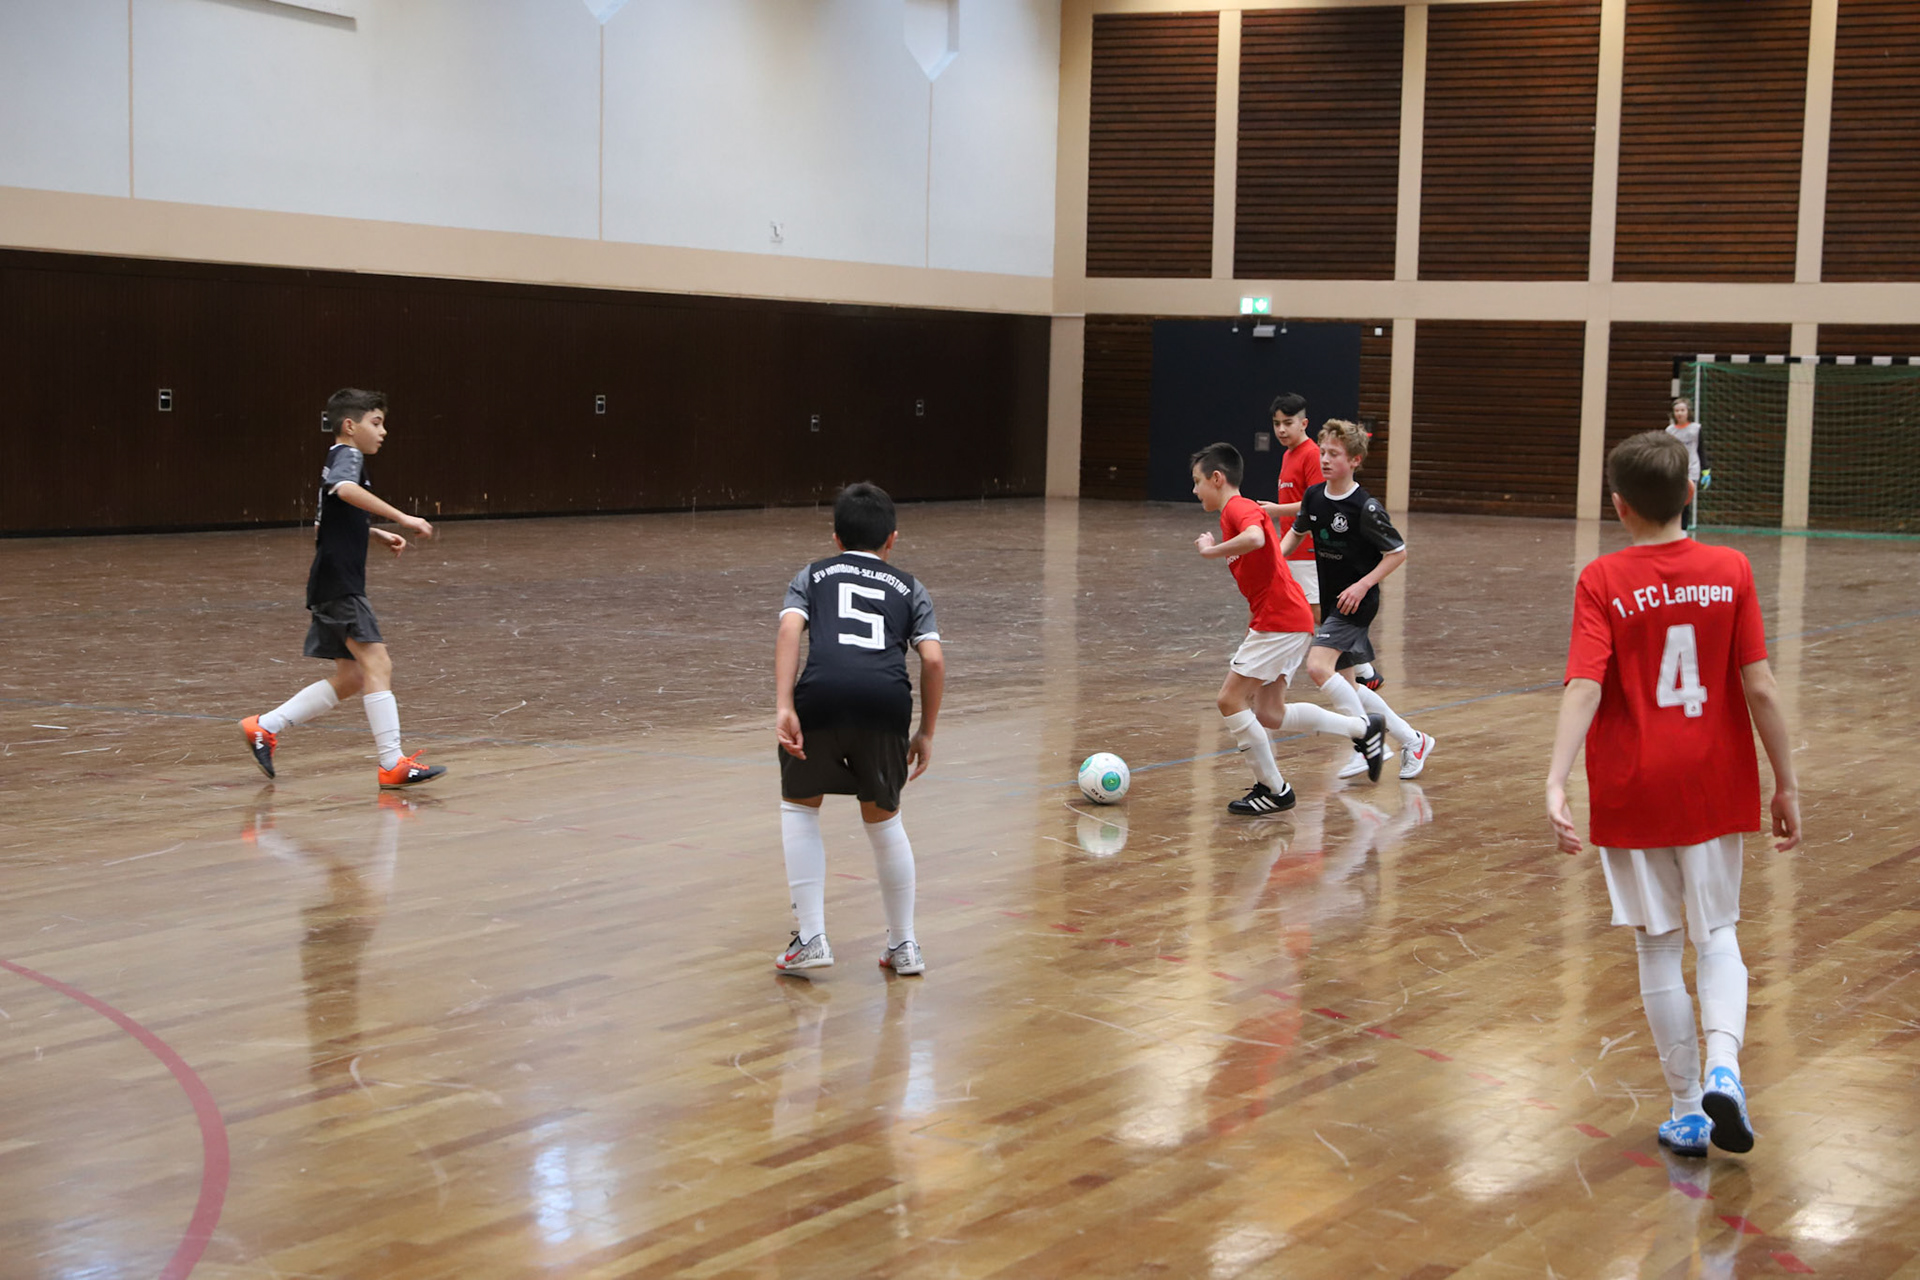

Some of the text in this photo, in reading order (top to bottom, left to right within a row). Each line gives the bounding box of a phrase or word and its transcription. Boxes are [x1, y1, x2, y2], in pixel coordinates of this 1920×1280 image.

[812, 570, 826, 584] JFV
[1612, 583, 1733, 619] 1. FC Langen
[838, 582, 886, 650] 5
[1656, 623, 1708, 718] 4
